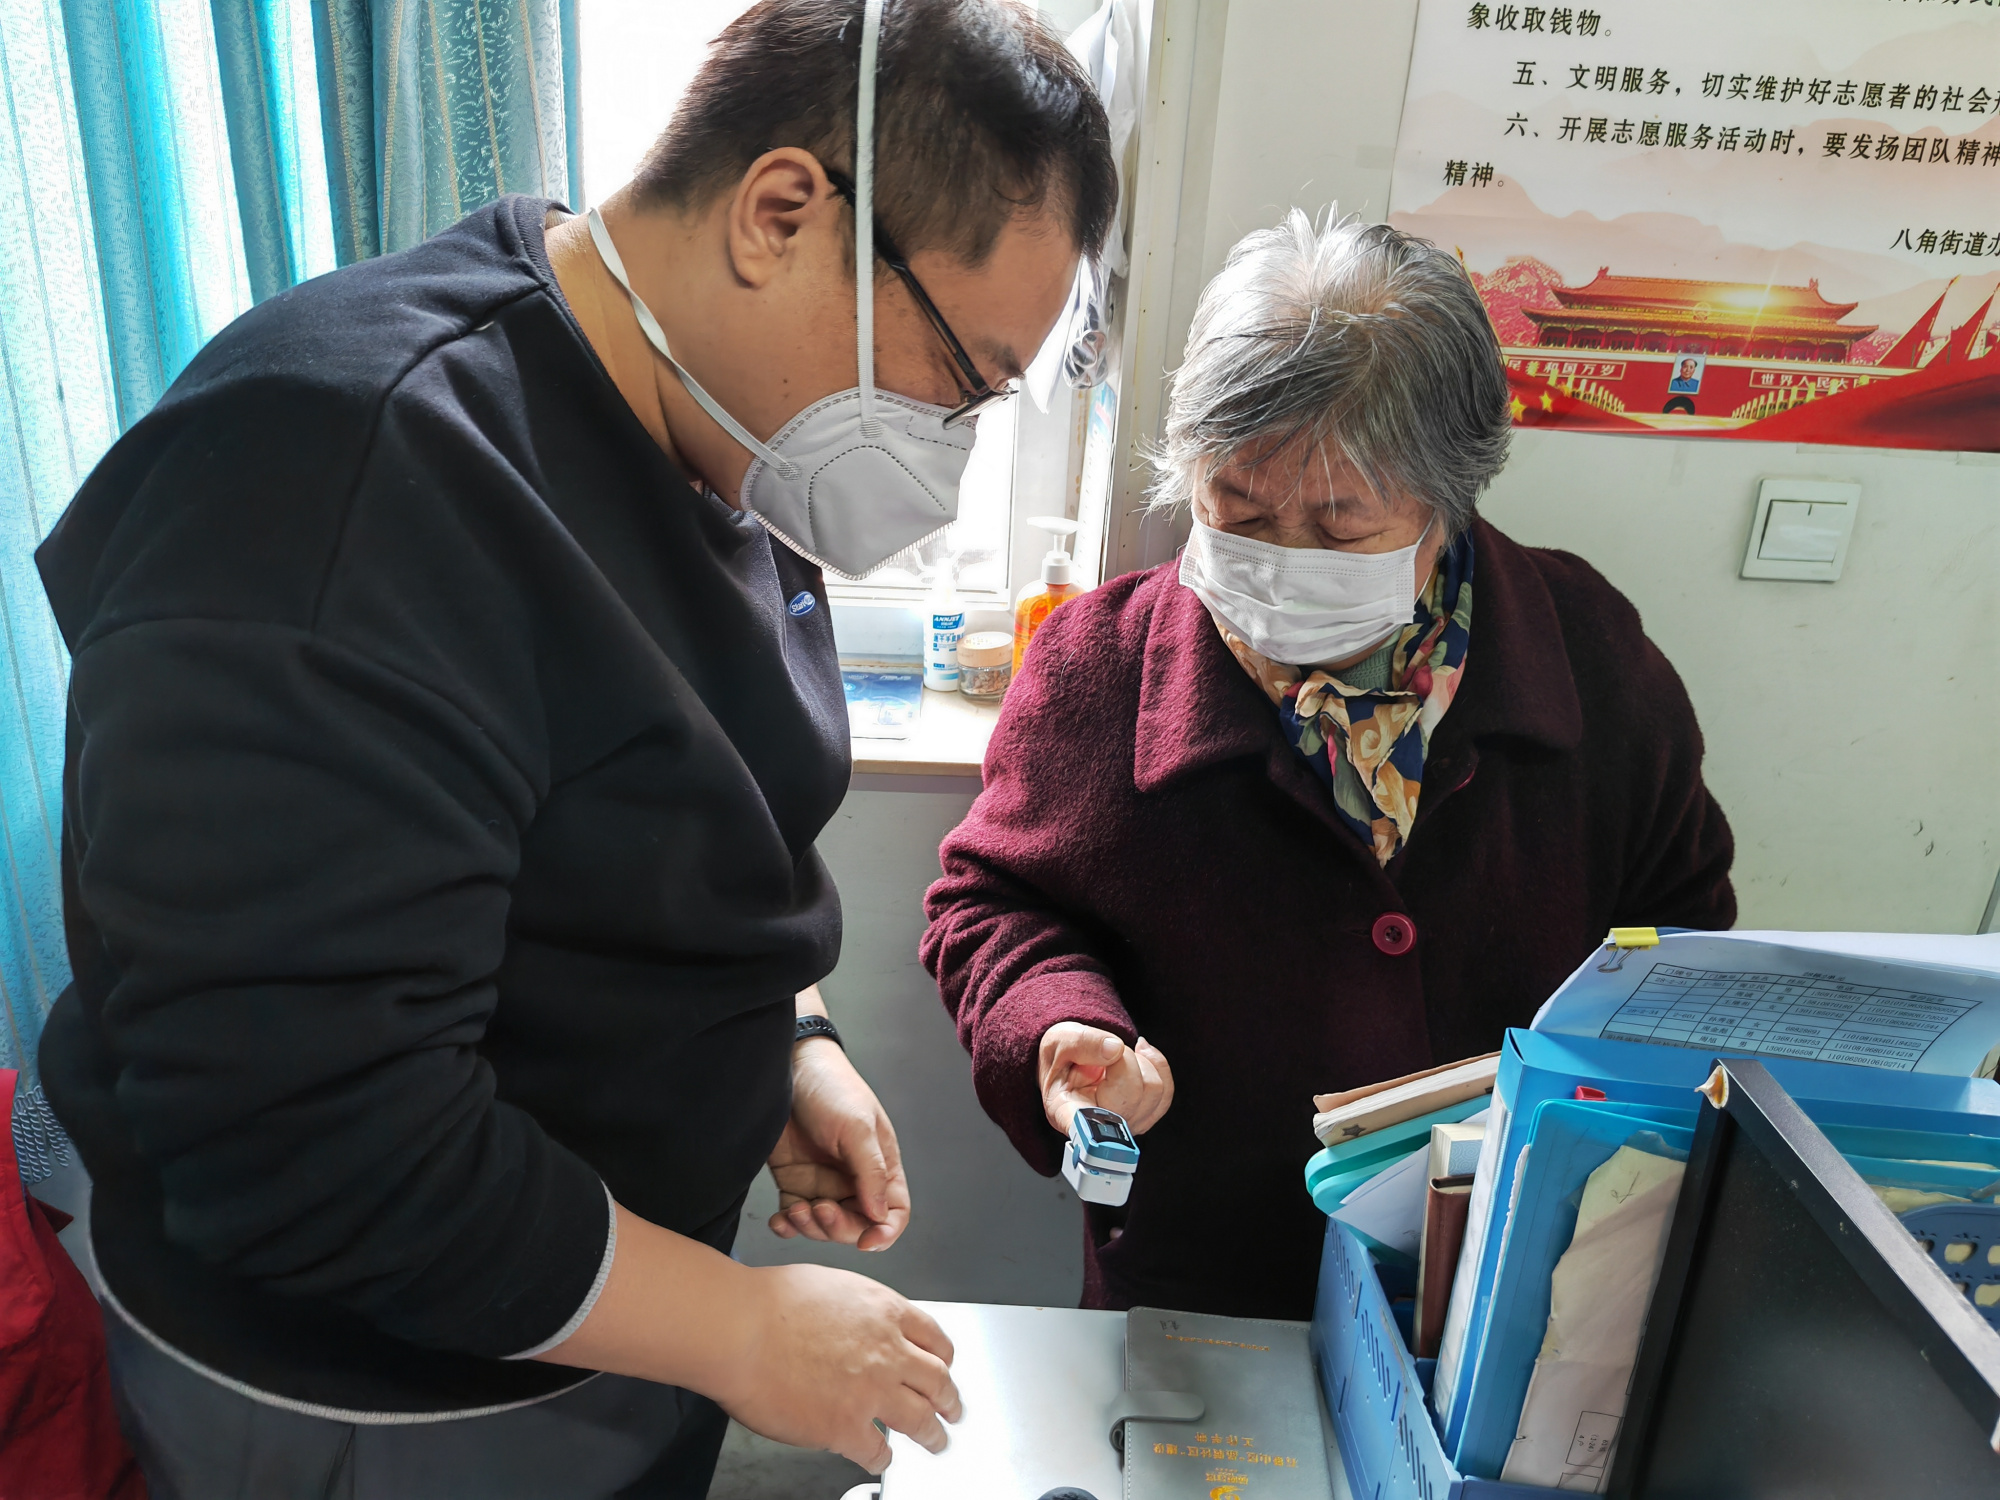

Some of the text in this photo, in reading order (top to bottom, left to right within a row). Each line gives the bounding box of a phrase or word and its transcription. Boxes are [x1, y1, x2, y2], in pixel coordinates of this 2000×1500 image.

[1466, 1, 1613, 38] 象收取钱物。
[1443, 160, 1506, 189] 精神。
